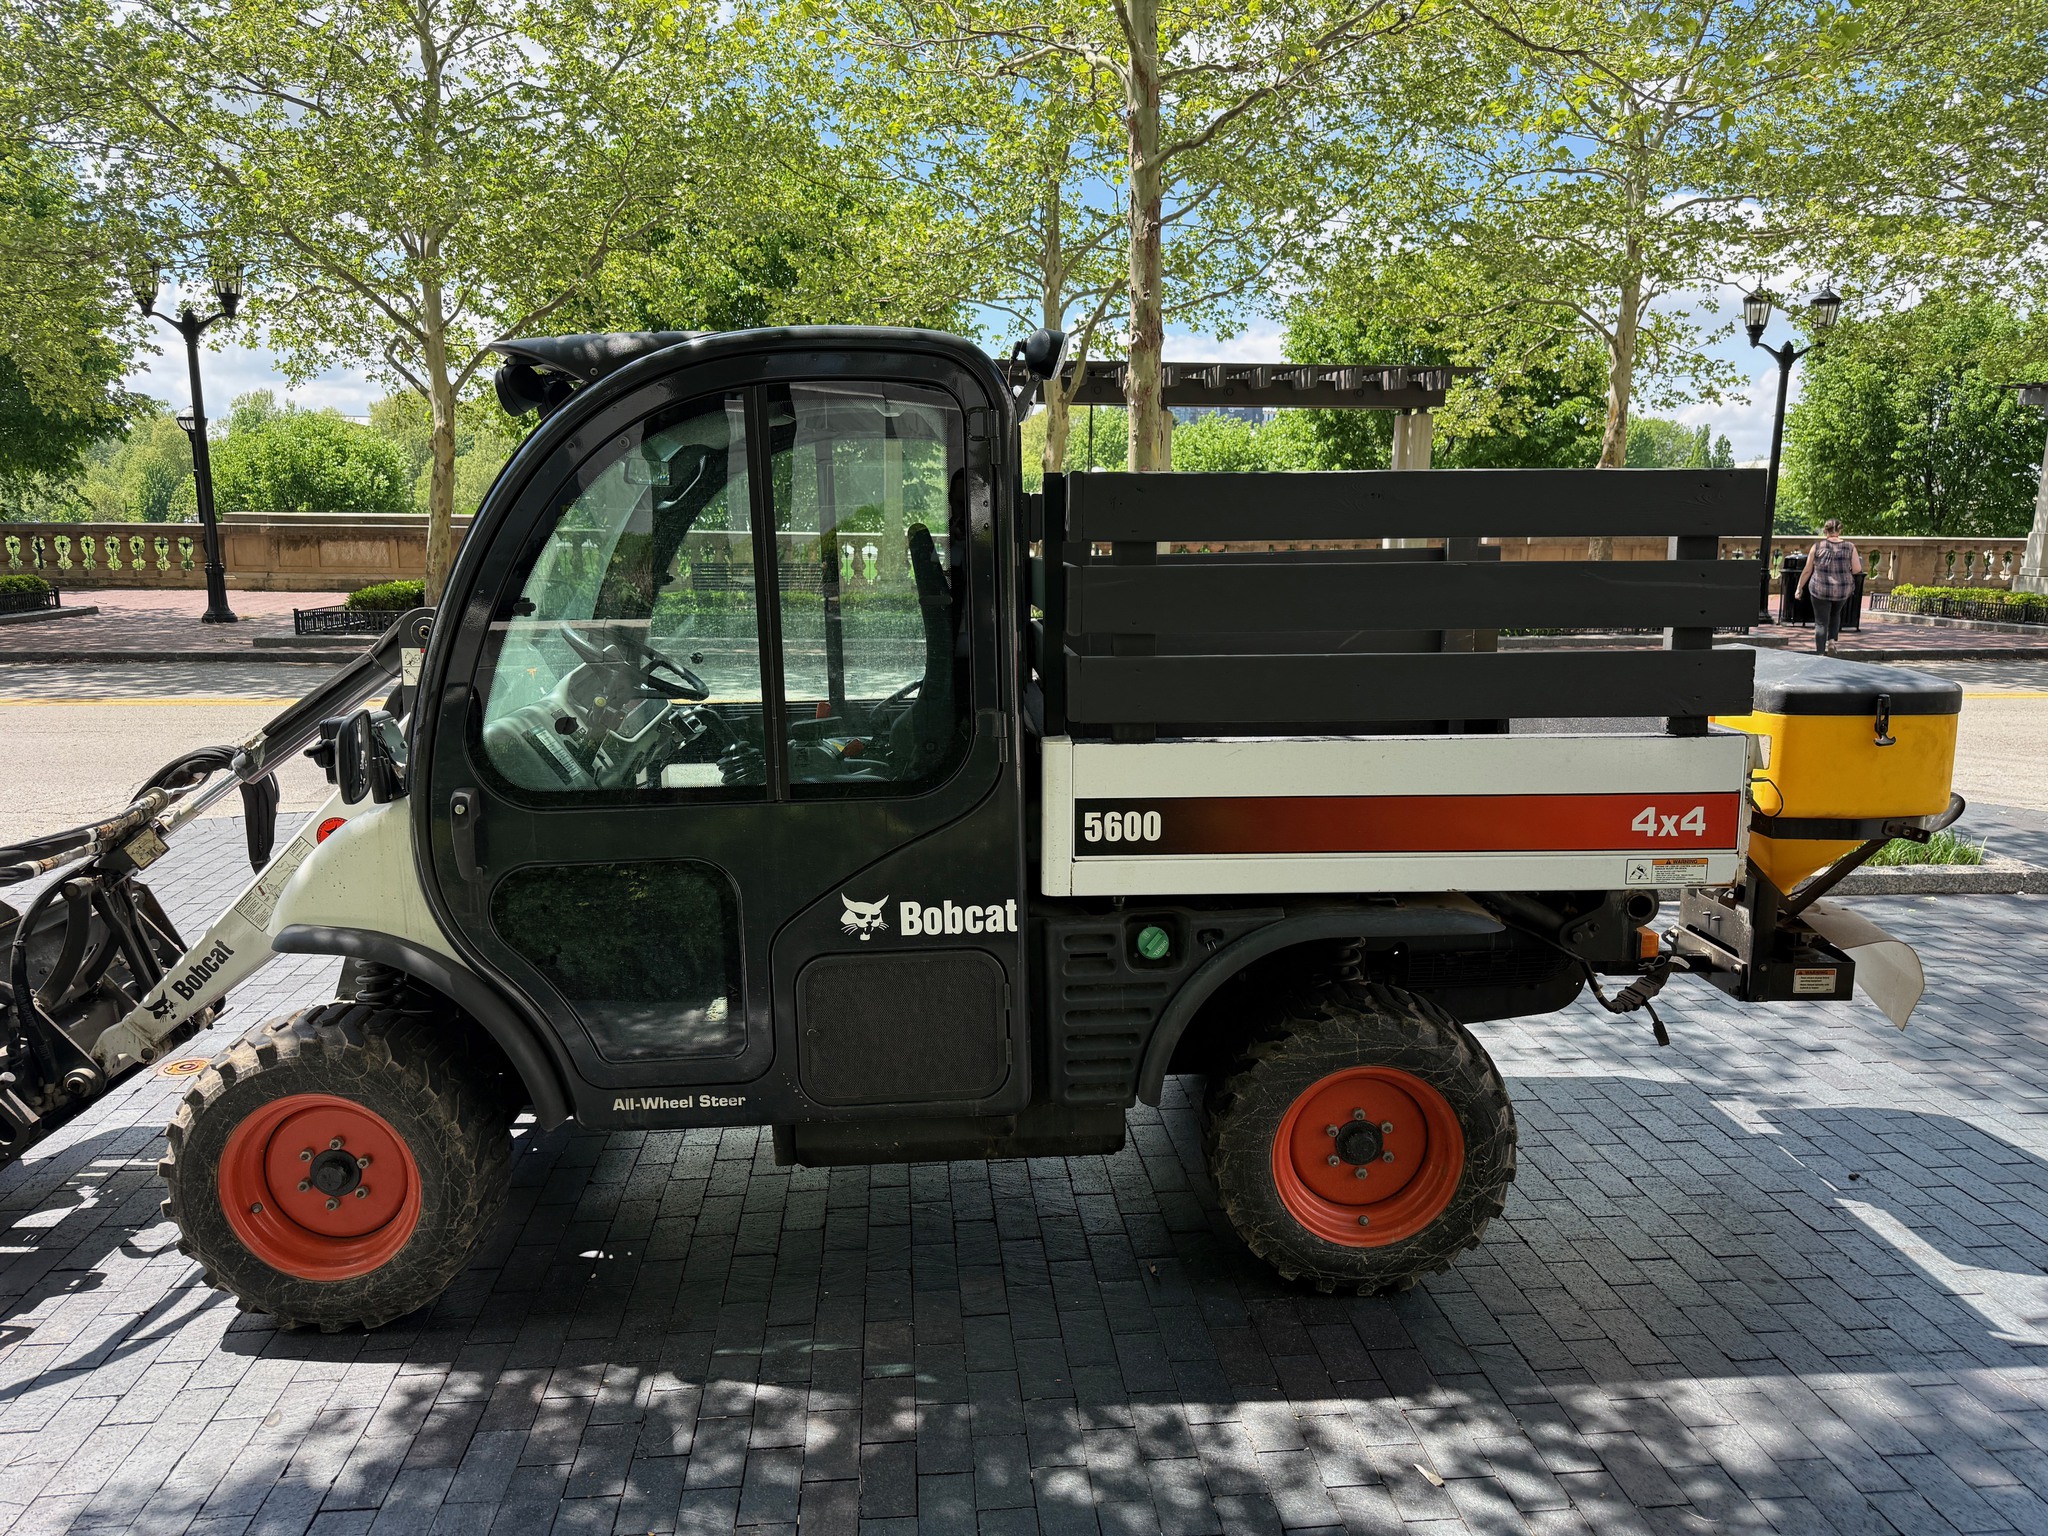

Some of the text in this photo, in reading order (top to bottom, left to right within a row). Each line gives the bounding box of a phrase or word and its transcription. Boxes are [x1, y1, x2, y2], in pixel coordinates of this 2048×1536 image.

[1084, 811, 1162, 842] 5600
[1631, 806, 1706, 837] 4x4
[900, 899, 1018, 936] Bobcat
[171, 939, 235, 1001] Bobcat
[613, 1094, 746, 1111] All-Wheel Steer
